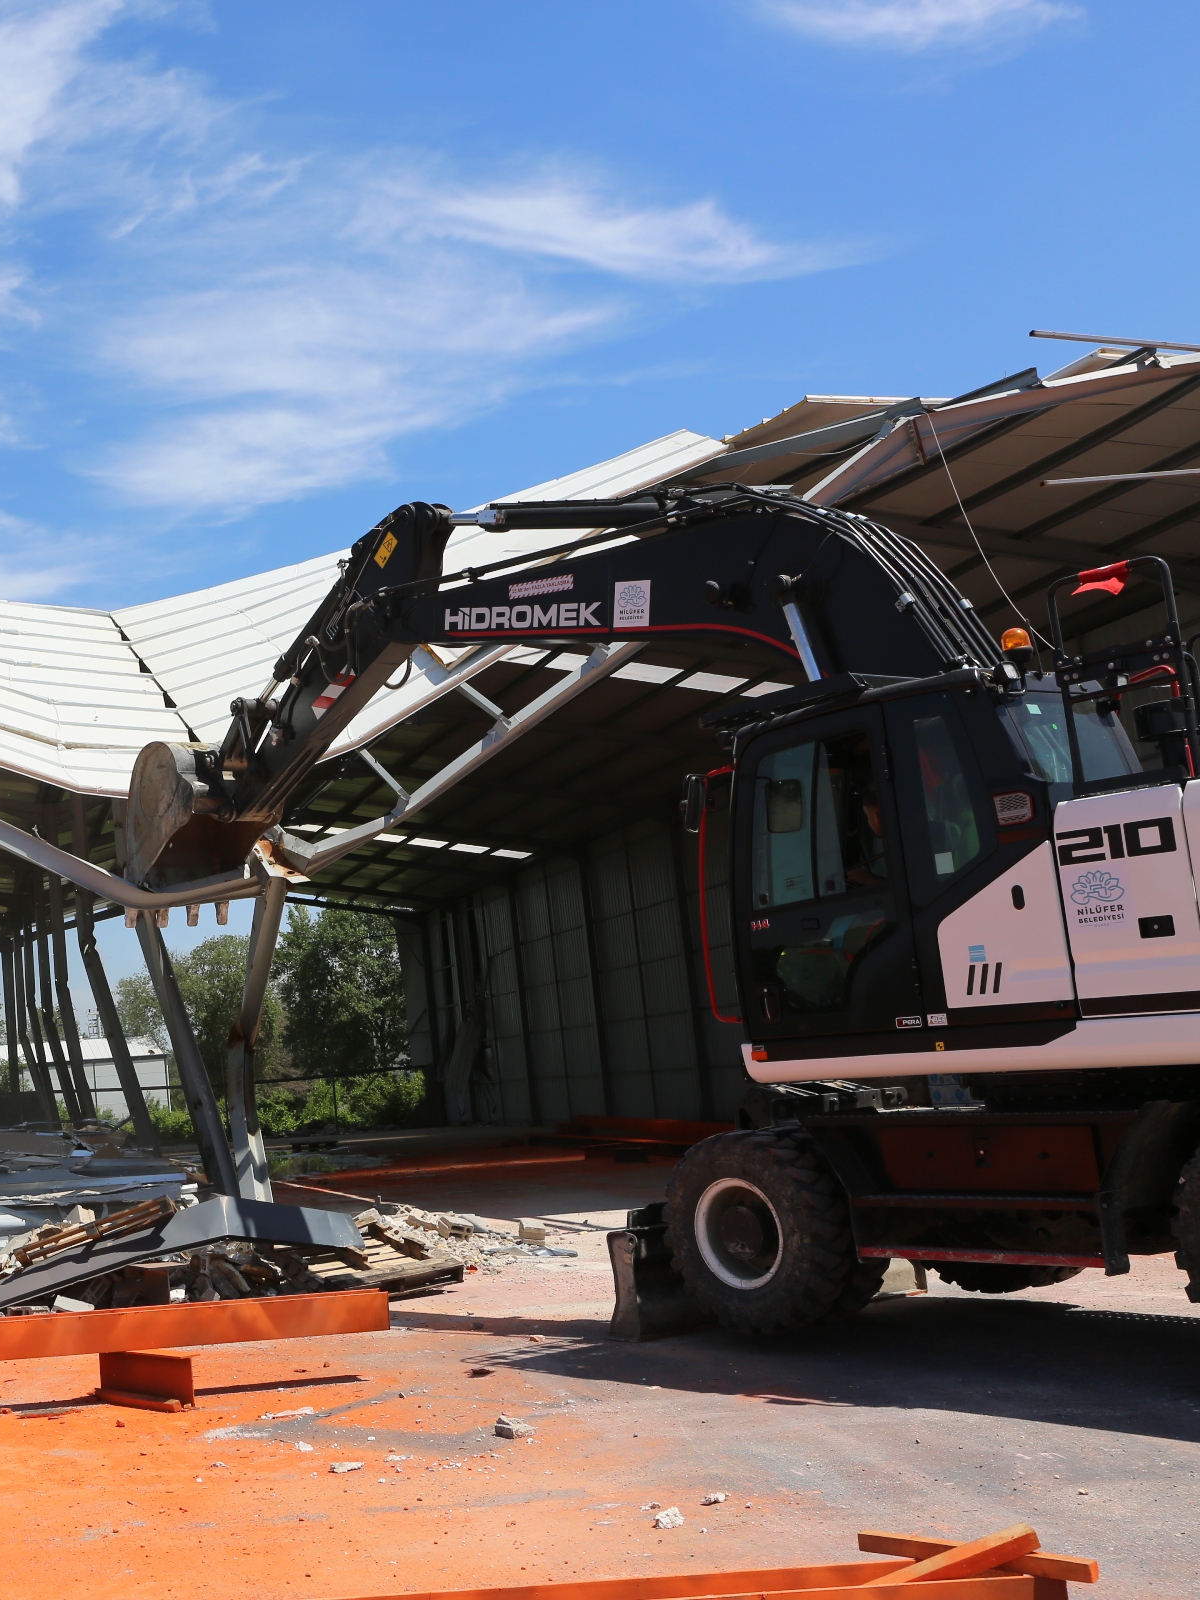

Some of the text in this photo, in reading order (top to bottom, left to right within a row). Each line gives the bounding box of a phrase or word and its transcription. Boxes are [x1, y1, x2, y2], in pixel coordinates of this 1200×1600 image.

[1055, 816, 1177, 866] 210
[1077, 904, 1125, 916] NİLÜFER
[1078, 912, 1125, 924] BELEDİYESİ
